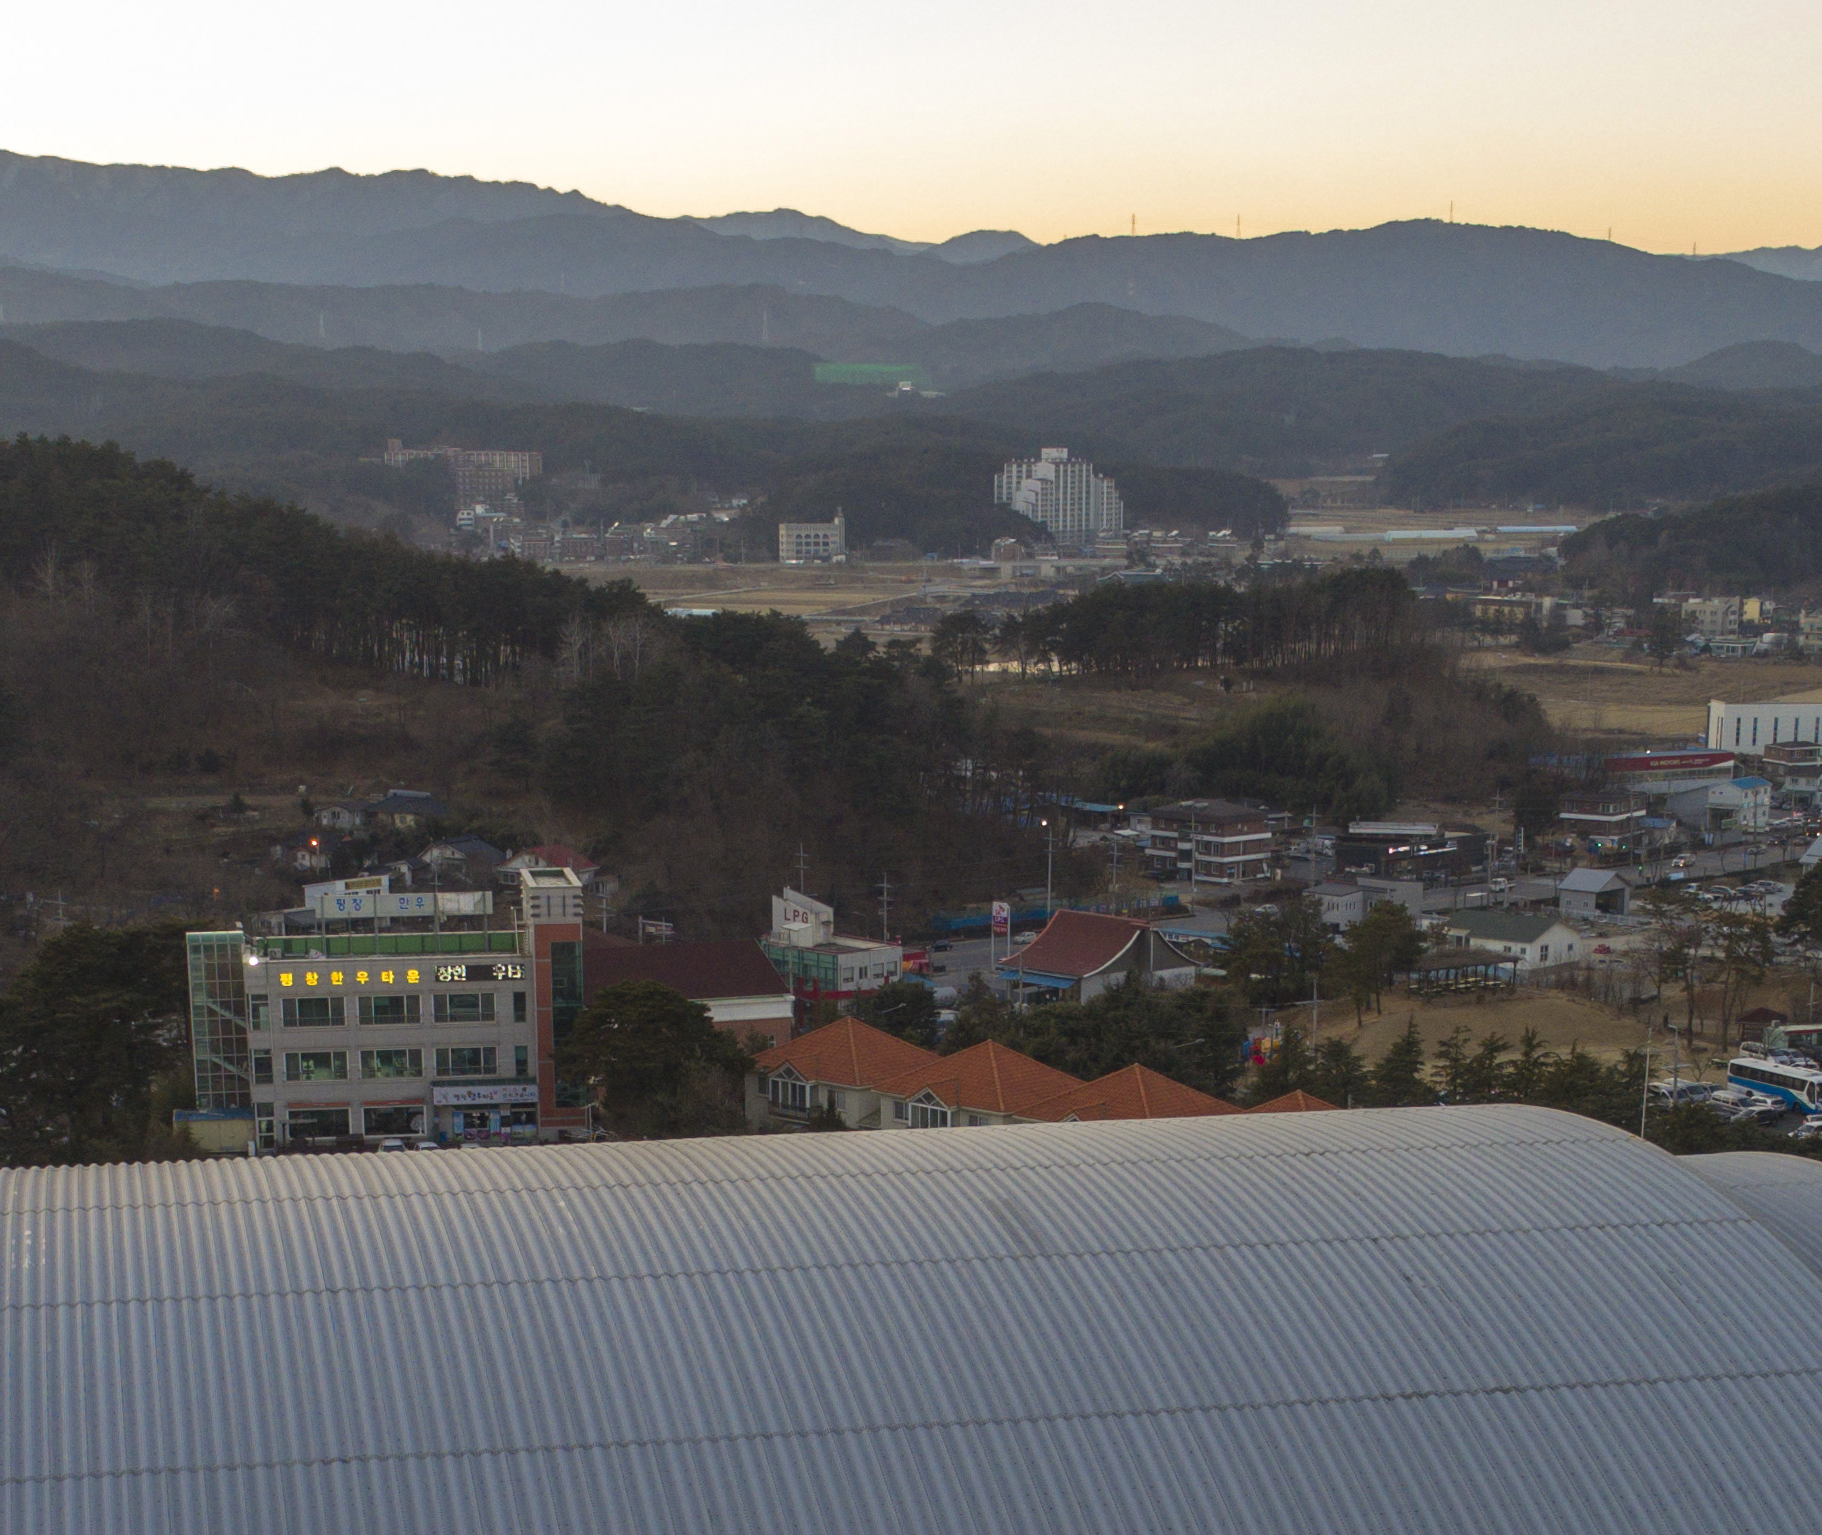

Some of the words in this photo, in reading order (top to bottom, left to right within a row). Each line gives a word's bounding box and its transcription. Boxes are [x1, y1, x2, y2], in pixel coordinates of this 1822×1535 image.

[336, 898, 363, 912] 평창
[398, 896, 426, 911] 한우
[784, 907, 809, 924] LPG
[279, 968, 421, 987] 평창한우타운
